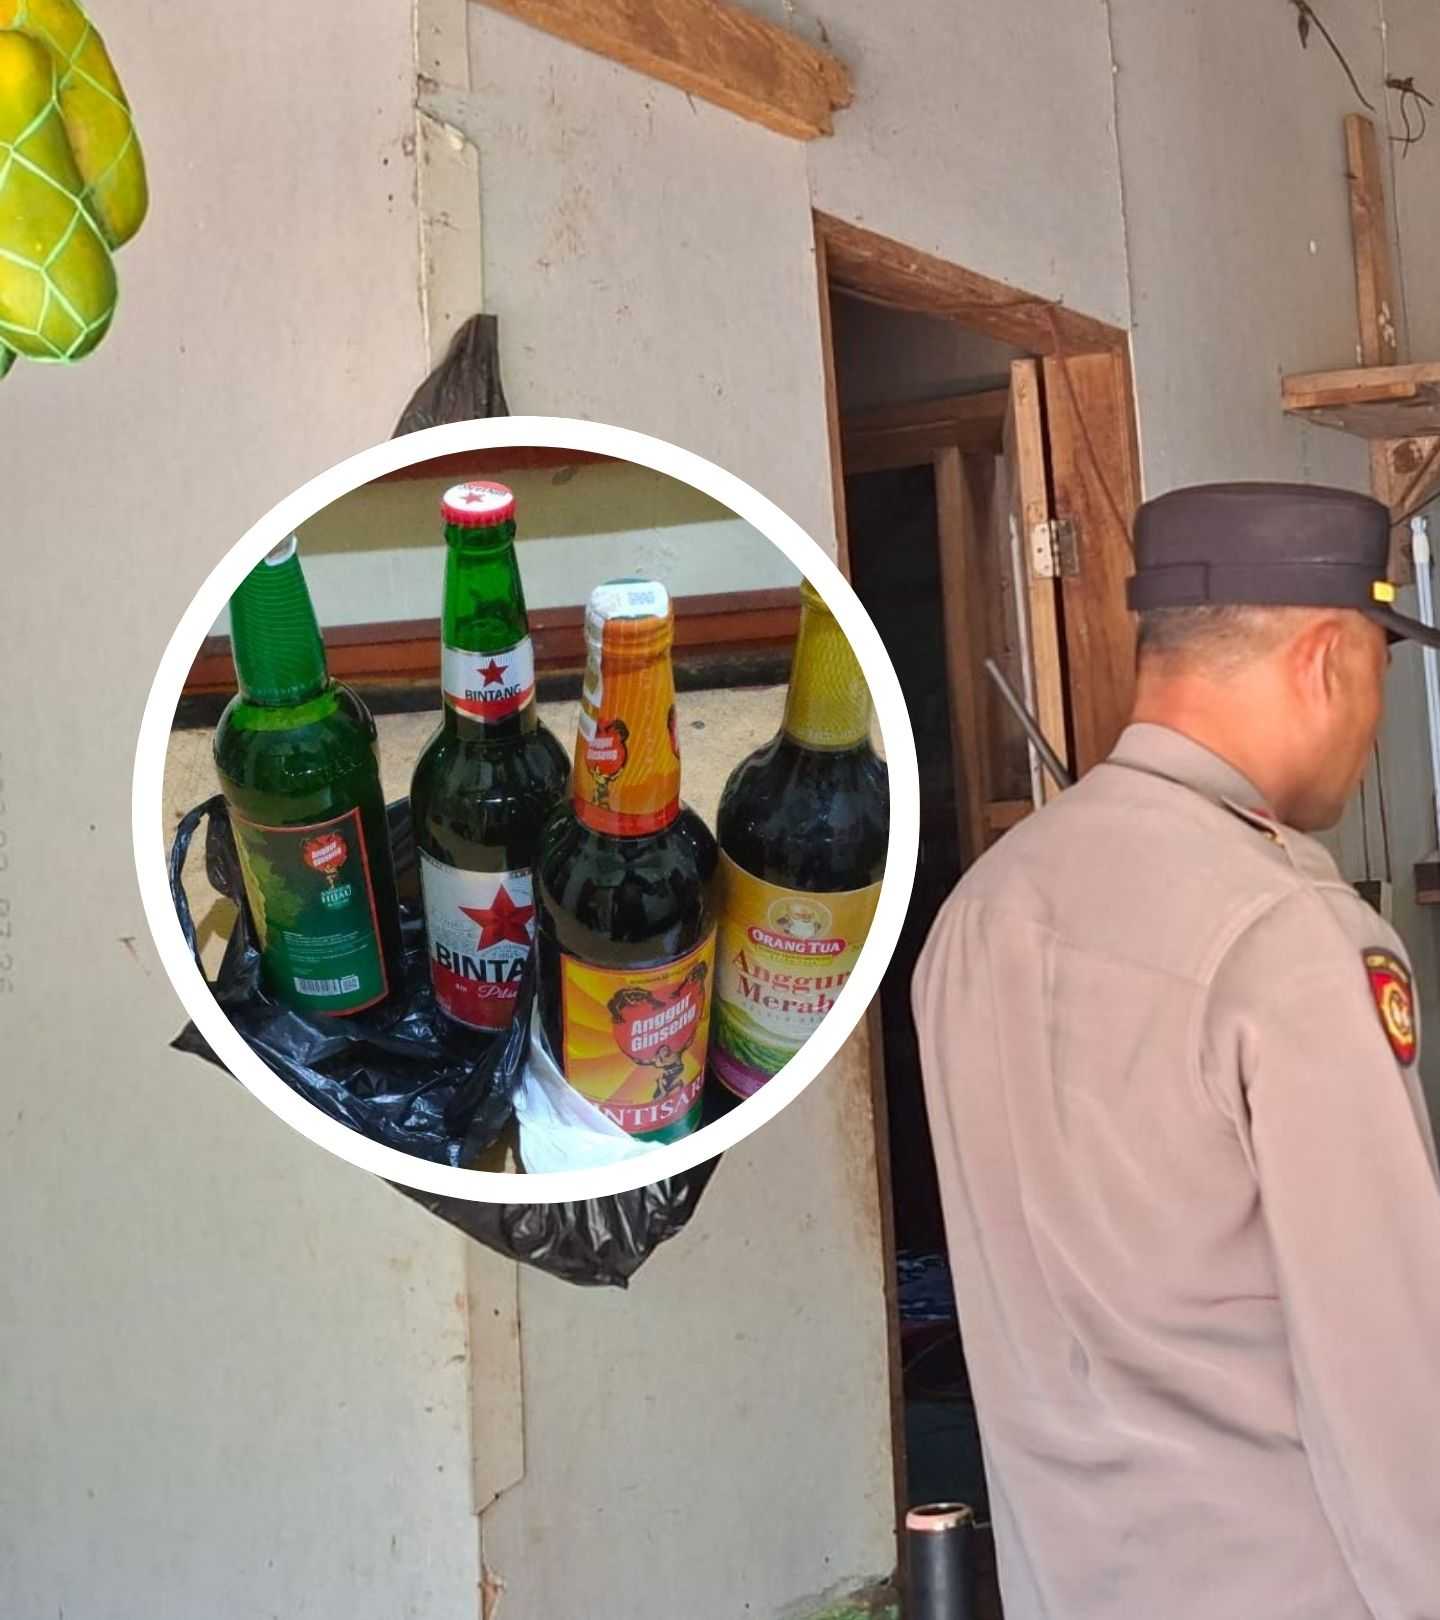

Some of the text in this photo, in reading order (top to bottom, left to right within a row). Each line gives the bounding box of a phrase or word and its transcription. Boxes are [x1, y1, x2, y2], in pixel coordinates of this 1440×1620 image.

[465, 684, 521, 702] BINTANG
[752, 929, 841, 953] ORANG TUA
[733, 949, 850, 994] Anggur
[631, 992, 691, 1036] Anggur
[738, 974, 834, 1014] Merah
[631, 1003, 696, 1051] Ginseng
